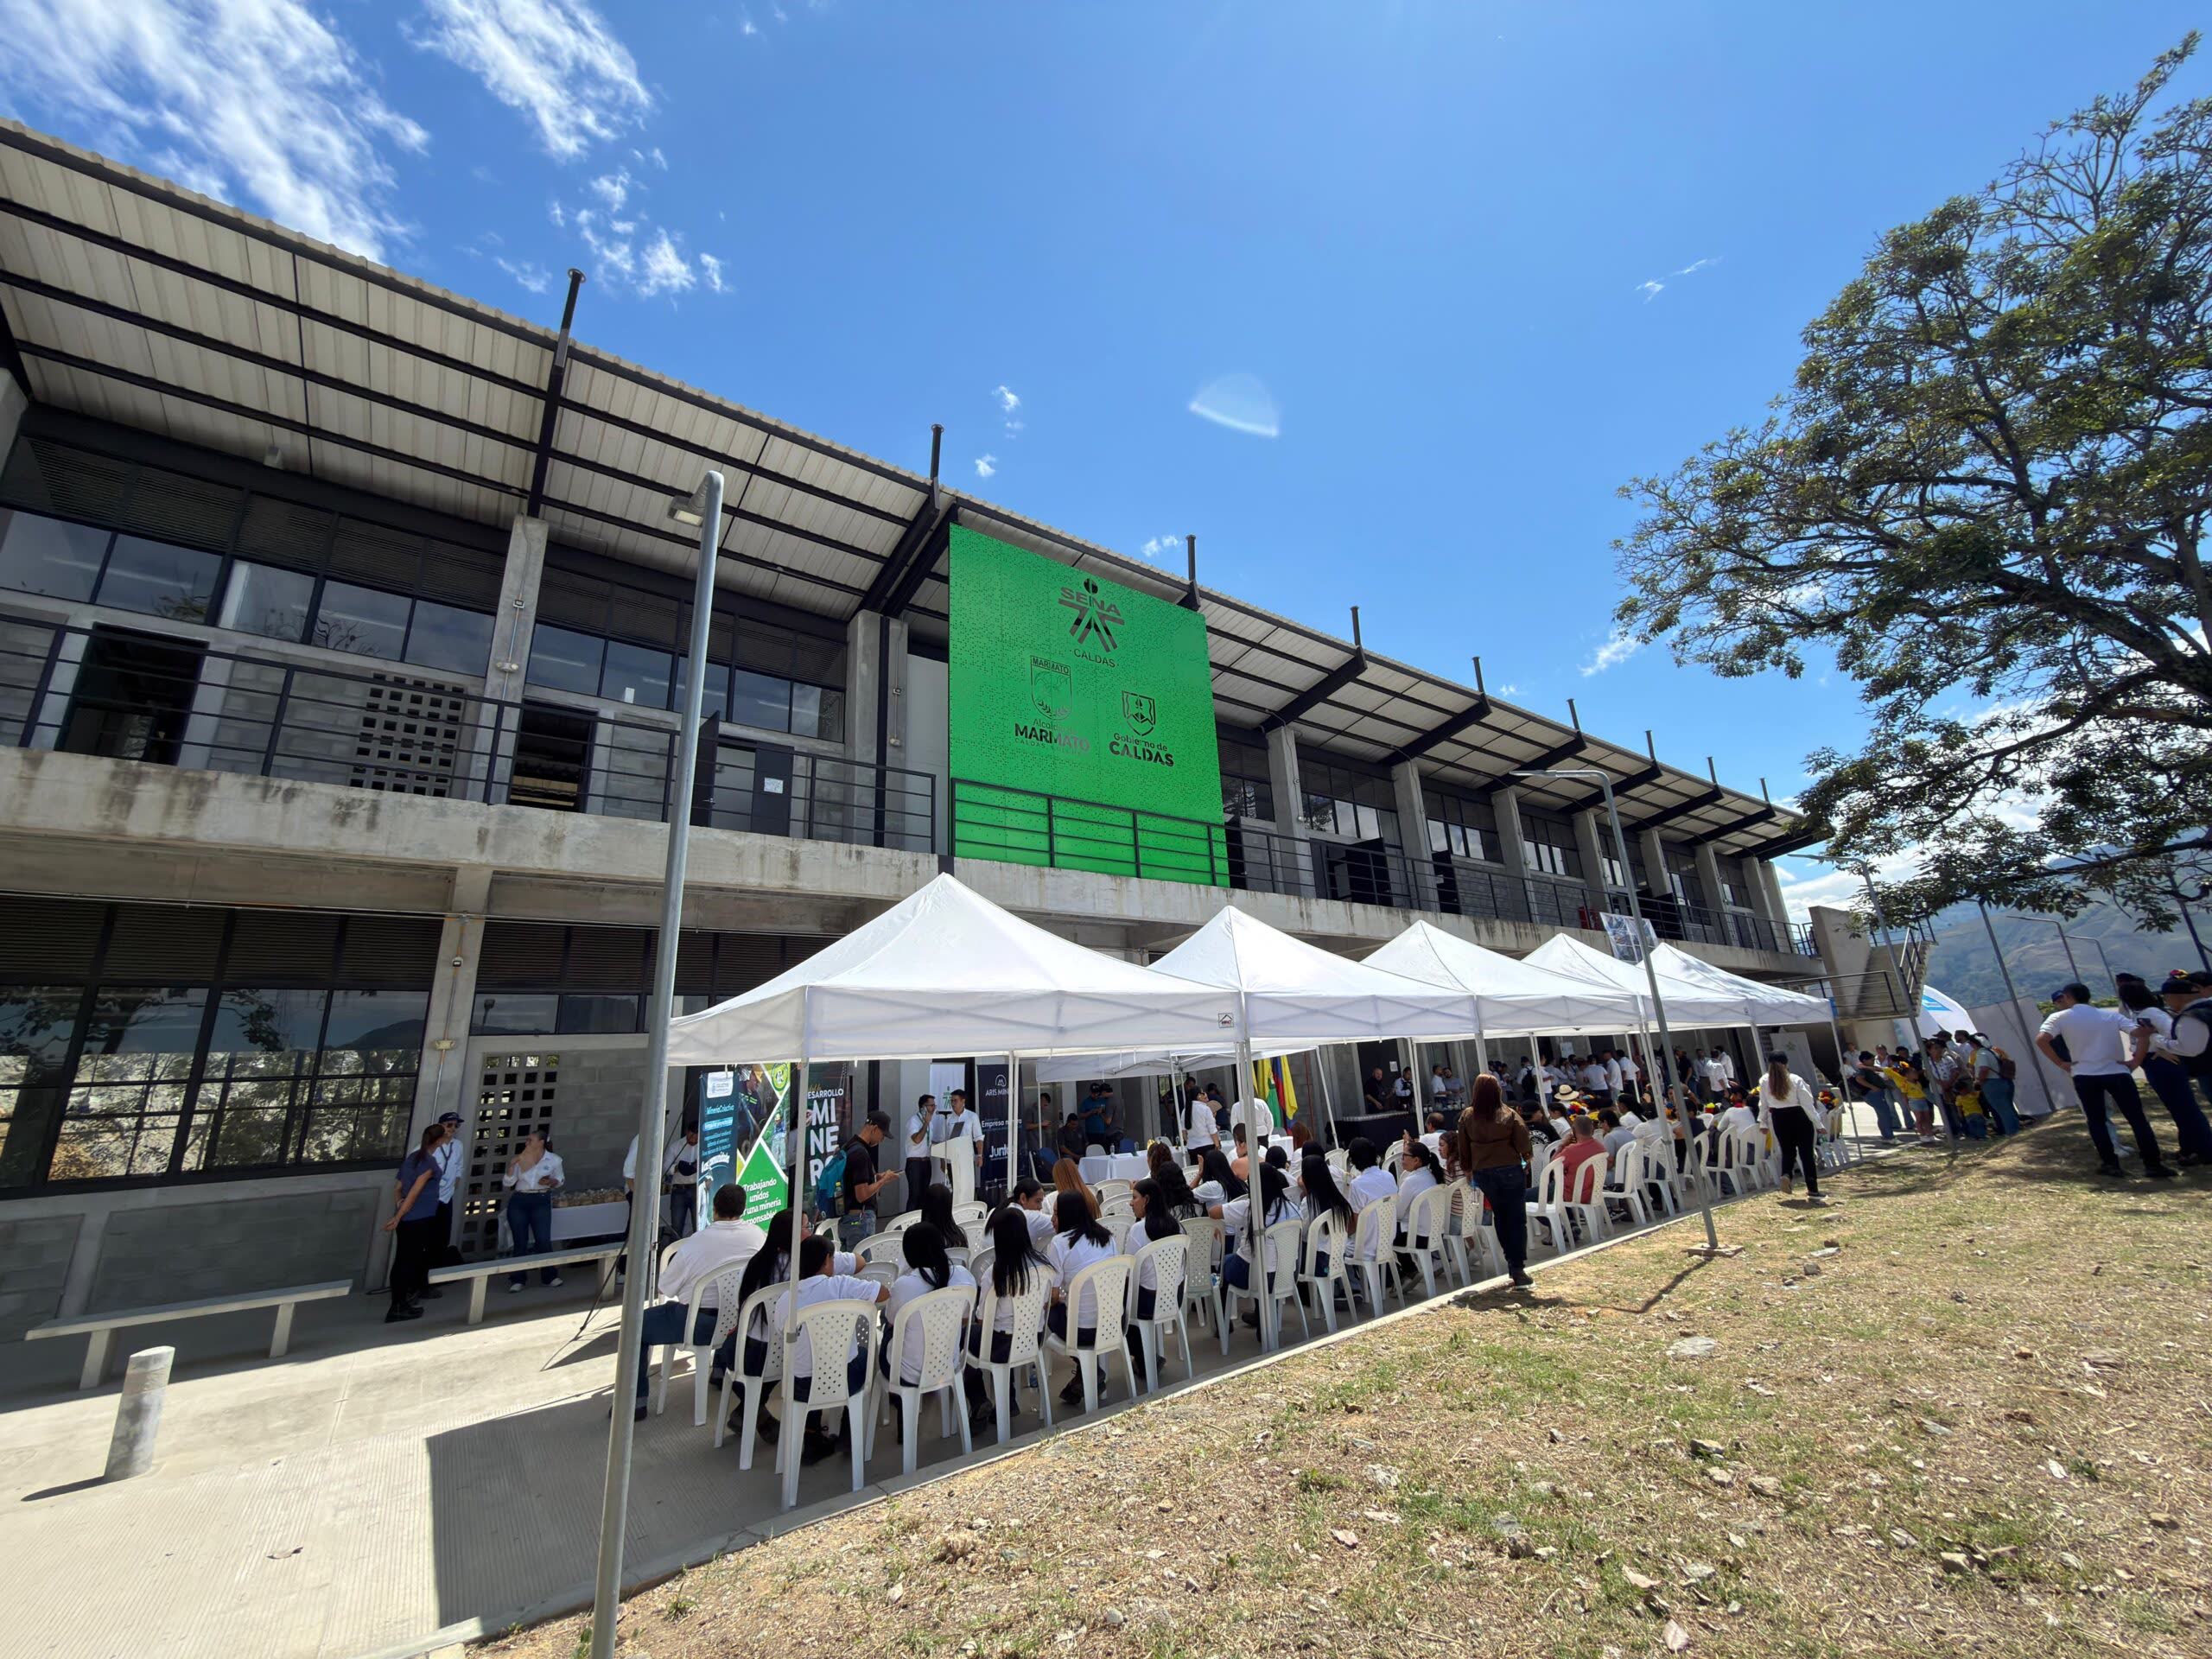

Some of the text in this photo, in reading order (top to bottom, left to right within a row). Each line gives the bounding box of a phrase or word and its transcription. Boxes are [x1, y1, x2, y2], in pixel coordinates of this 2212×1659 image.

[1060, 587, 1122, 617] SENA
[1033, 657, 1070, 674] MARMATO
[1073, 648, 1116, 668] CALDAS
[1014, 722, 1091, 752] MARMATO
[1114, 733, 1168, 752] Gobierno de
[1109, 741, 1174, 767] CALDAS
[807, 1088, 844, 1100] ESARROLLO
[985, 1088, 997, 1096] ARIS
[981, 1120, 1005, 1129] Empresa
[749, 1191, 769, 1202] unidos
[747, 1205, 759, 1215] una
[759, 1198, 781, 1211] minería
